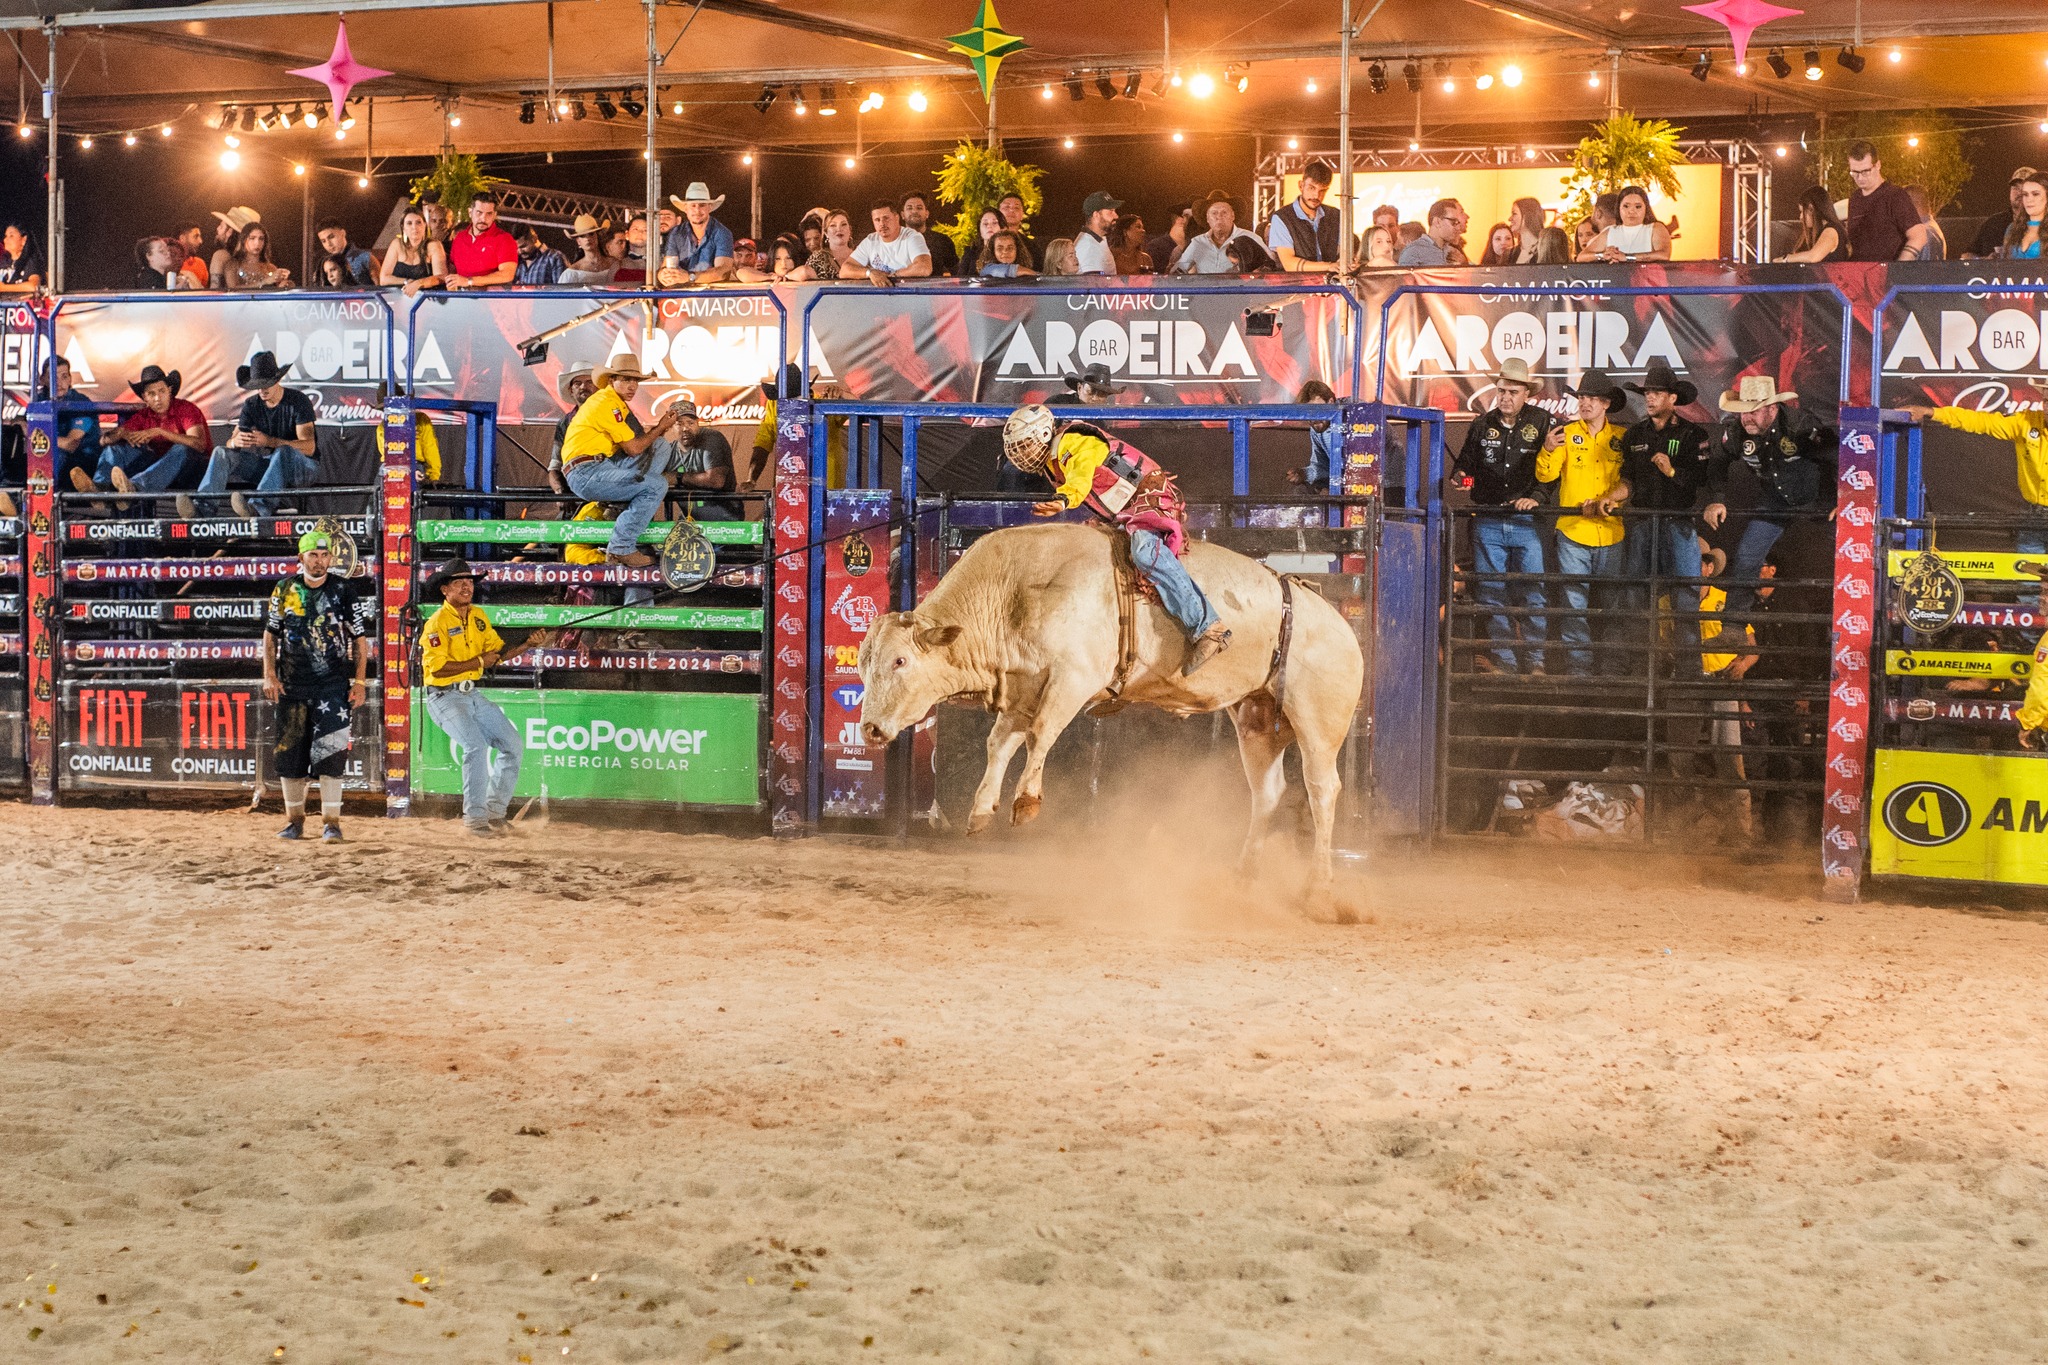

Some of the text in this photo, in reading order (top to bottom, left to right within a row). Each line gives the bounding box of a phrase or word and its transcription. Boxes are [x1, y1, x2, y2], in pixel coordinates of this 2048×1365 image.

[294, 302, 394, 321] CAMAROT
[662, 297, 771, 317] CAMAROTE
[997, 319, 1258, 375] AROEIRA
[1089, 339, 1117, 356] BAR
[1404, 311, 1685, 371] AROEIRA
[1503, 332, 1533, 350] BAR
[1883, 309, 2048, 371] ARO
[1993, 331, 2025, 349] BAR
[310, 347, 333, 363] BAR
[70, 521, 365, 538] FIAT CONFIALLE FIAT CONFIALLE FIAT COLLE
[448, 525, 485, 534] EcoPower
[511, 526, 548, 534] EcoPower
[706, 526, 745, 535] EcoPower
[680, 550, 698, 562] 20
[105, 564, 160, 579] MATÃO
[169, 564, 224, 578] RODEO
[234, 562, 287, 577] MUSIC
[1947, 561, 1995, 569] RELINHA
[535, 568, 593, 582] RODEO
[603, 569, 660, 582] MUSIC
[1920, 576, 1946, 586] TOP
[1920, 585, 1943, 599] 20
[92, 605, 158, 618] CONFIALLE
[174, 605, 190, 619] FIAT
[194, 604, 261, 618] CONFIALLE
[510, 611, 548, 620] EcoPower
[706, 614, 746, 623] EcoPower
[1954, 609, 2034, 627] MATÃO
[103, 644, 264, 659] MATÃO RODEO MUS
[601, 656, 657, 669] MUSIC
[668, 657, 711, 670] 2024
[835, 666, 859, 674] SAUDA
[1919, 660, 1992, 671] AMARELINHA
[79, 689, 250, 750] FIAT FIAT
[1949, 704, 2012, 721] MATÃ
[526, 718, 707, 755] EcoPower
[69, 755, 255, 775] CONFIALLE CONFIALLE
[544, 755, 689, 772] ENERGIA SOLAR
